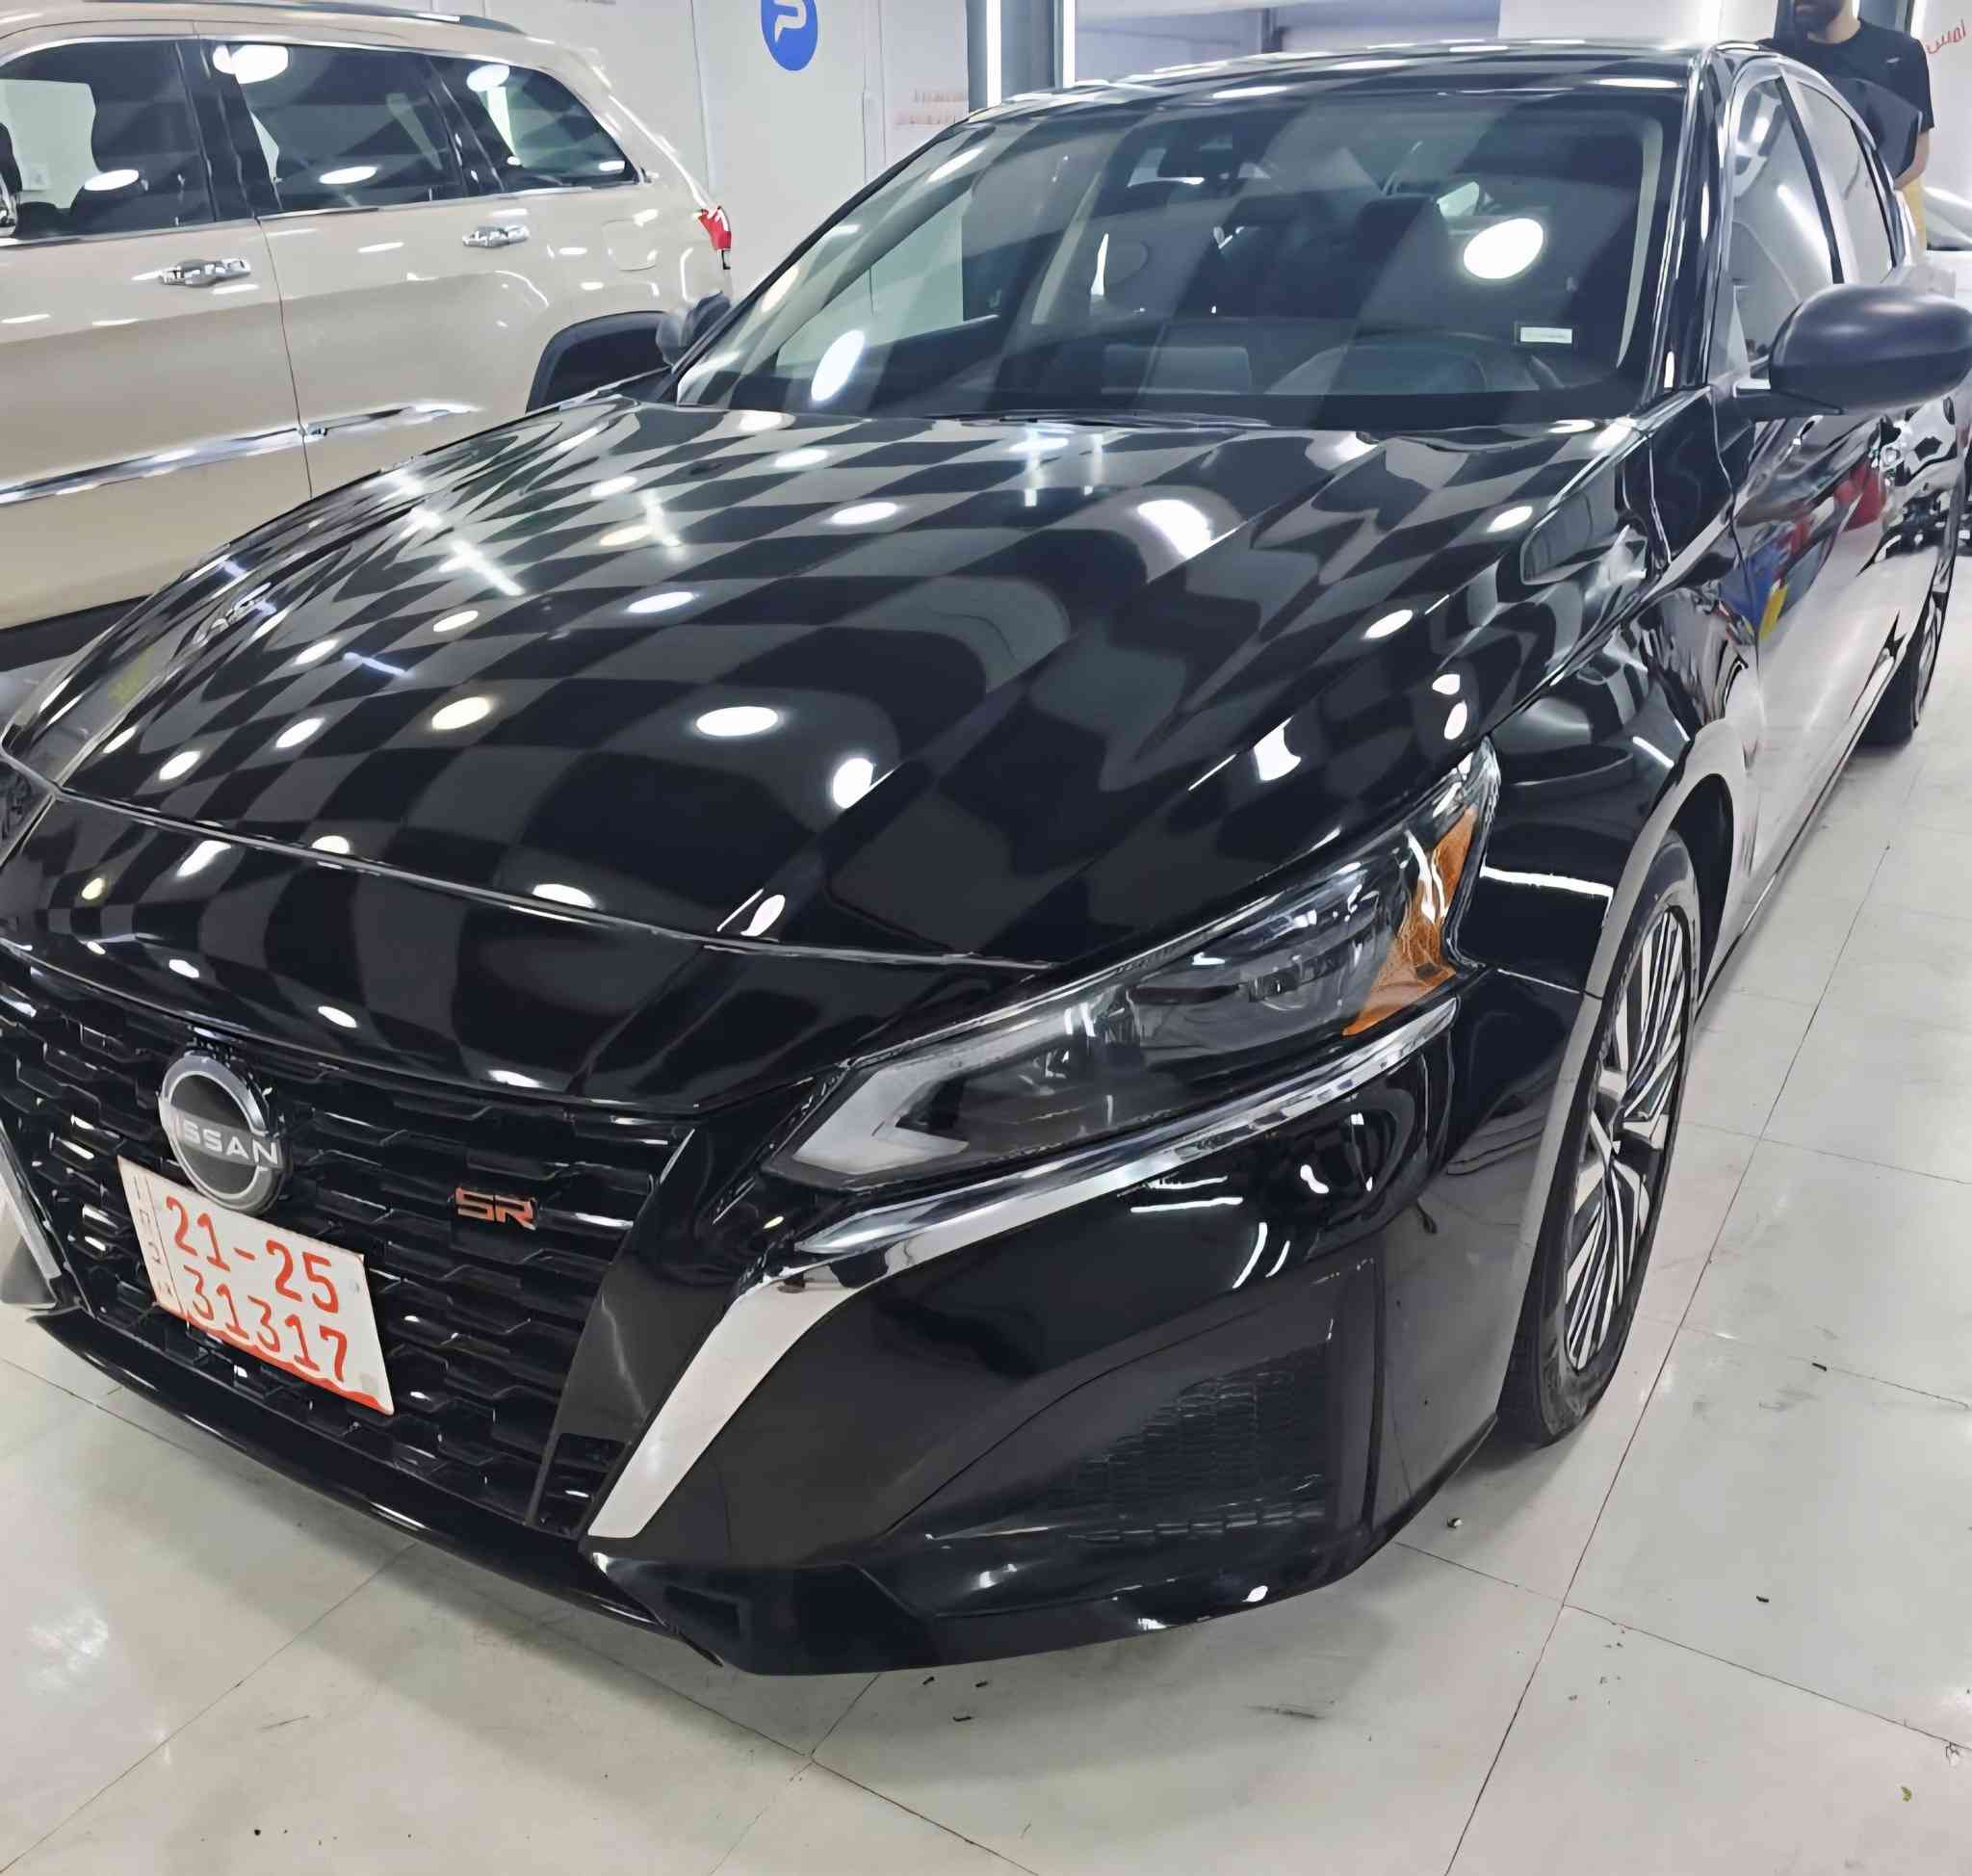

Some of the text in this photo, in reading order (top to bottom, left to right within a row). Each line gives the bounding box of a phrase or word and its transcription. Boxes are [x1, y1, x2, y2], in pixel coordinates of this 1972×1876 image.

[166, 1196, 339, 1314] 21-25
[455, 1186, 536, 1231] SR
[184, 1264, 348, 1382] 31317
